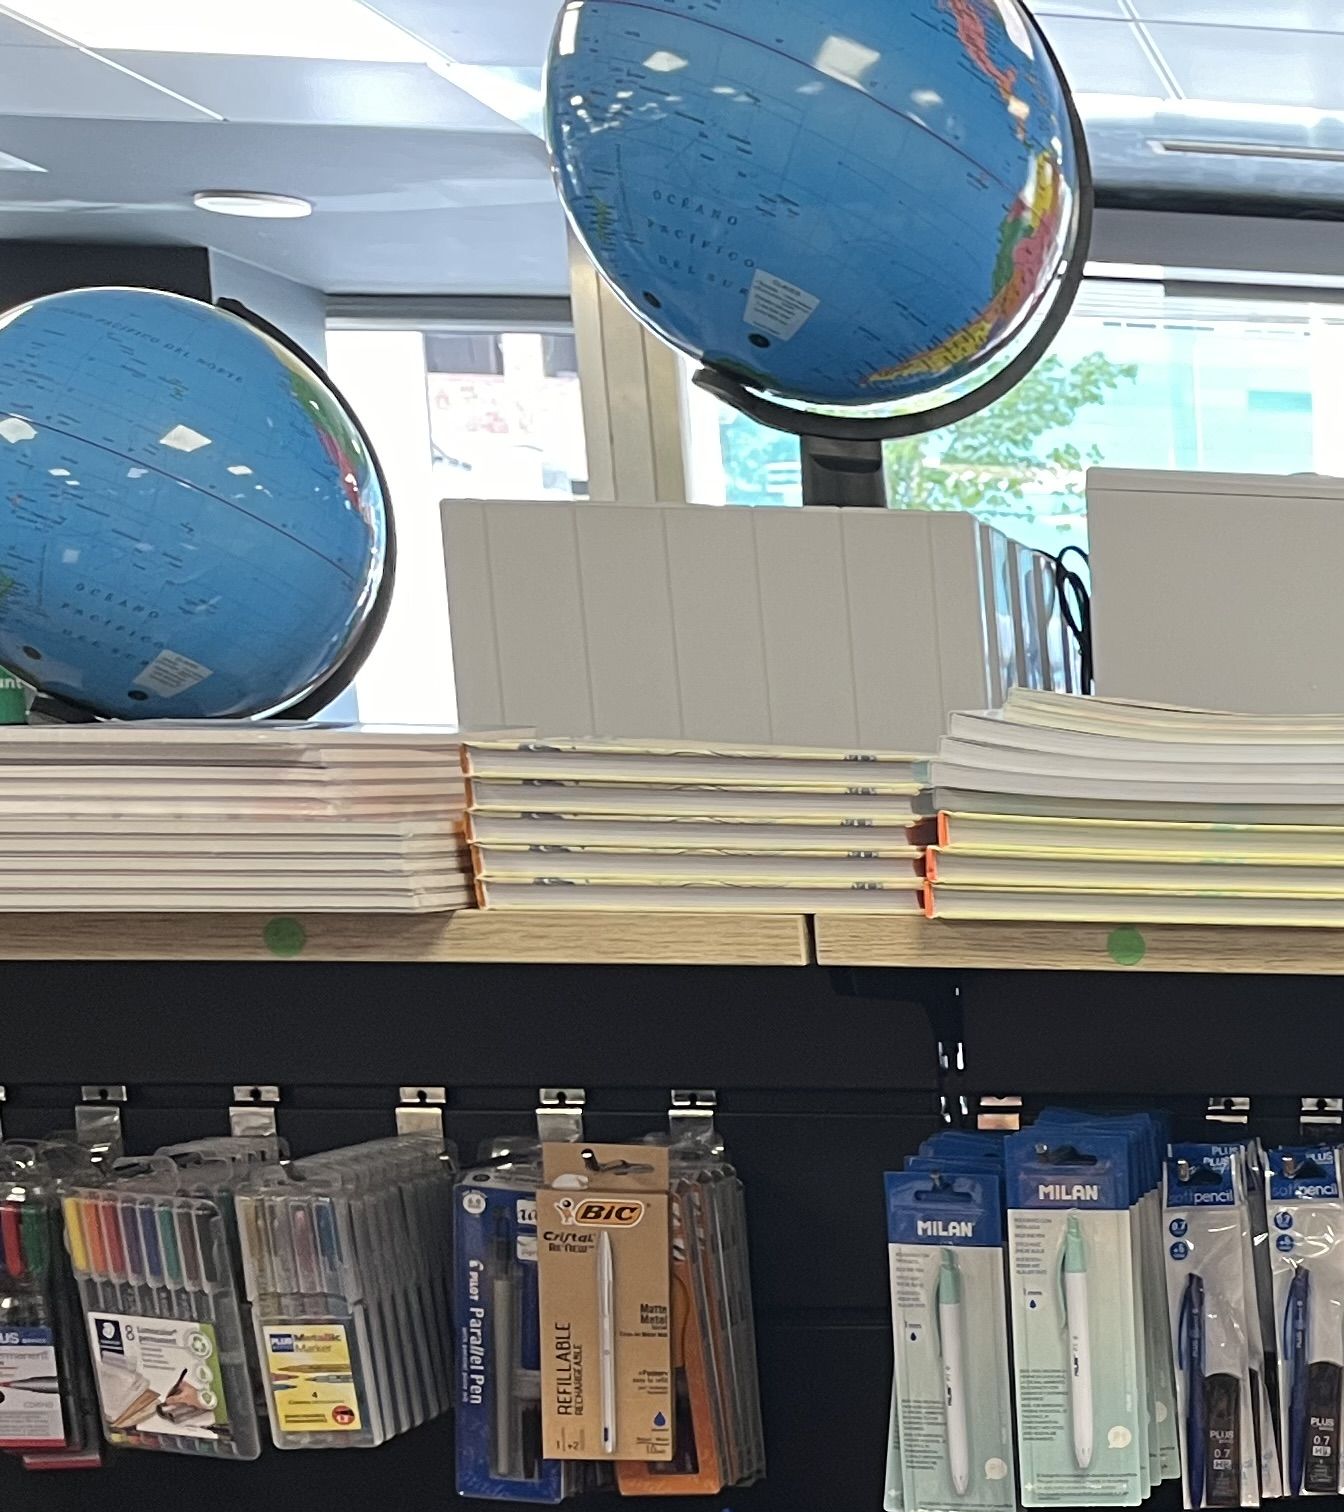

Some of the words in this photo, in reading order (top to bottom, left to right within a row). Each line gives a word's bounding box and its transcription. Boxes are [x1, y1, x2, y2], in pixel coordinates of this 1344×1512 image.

[1038, 1184, 1099, 1201] MILAN
[578, 1204, 639, 1222] BIC
[916, 1219, 974, 1237] MILAN
[467, 1270, 479, 1301] PILOT
[124, 1324, 136, 1341] 8
[293, 1332, 342, 1343] Metallic
[467, 1307, 485, 1371] Parallel
[556, 1321, 572, 1416] REFILLABLE
[574, 1343, 584, 1416] RECHARGEABLE
[468, 1374, 485, 1405] Pen
[1310, 1417, 1335, 1427] PLUS
[1313, 1435, 1330, 1445] 0.7
[1214, 1448, 1231, 1458] 0.7
